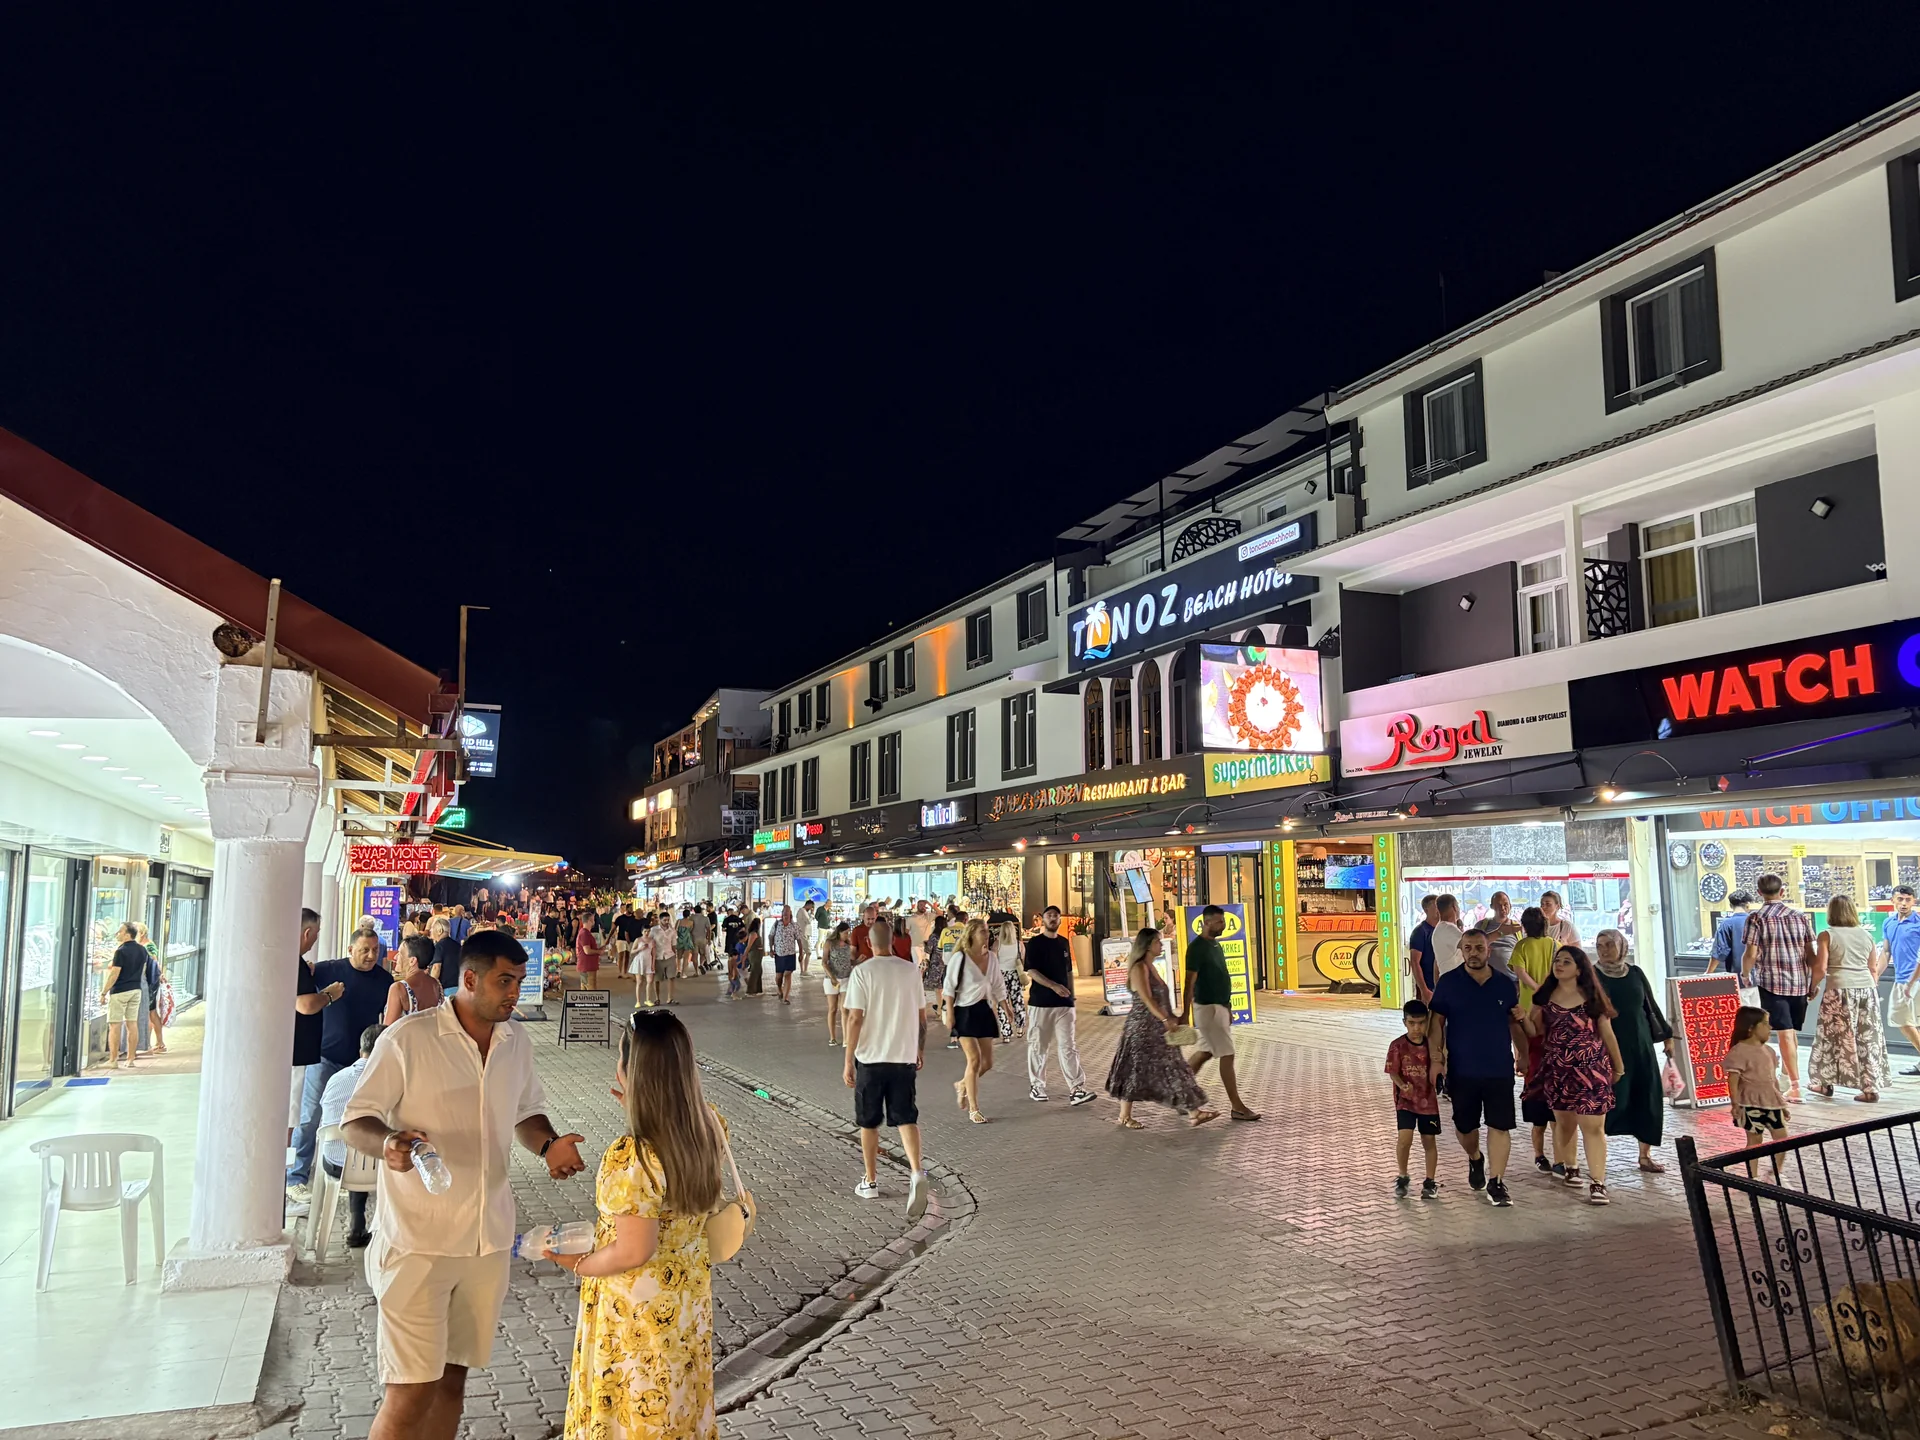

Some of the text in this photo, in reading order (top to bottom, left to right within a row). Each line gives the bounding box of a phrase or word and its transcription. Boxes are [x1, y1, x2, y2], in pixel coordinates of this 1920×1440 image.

[1184, 579, 1238, 623] BEACH
[1662, 644, 1875, 721] WATCH
[1497, 718, 1520, 727] DIAMOND
[1526, 715, 1537, 723] GEM
[1538, 711, 1568, 721] SPECIALIST
[476, 739, 495, 747] HILL
[1363, 710, 1499, 771] Royal
[1463, 745, 1503, 759] JEWELRY
[1213, 754, 1313, 788] supermarket
[1084, 778, 1149, 802] RESTAURANT
[1150, 776, 1159, 793] &
[1160, 773, 1187, 794] BAR
[350, 847, 437, 859] SWAP MONEY
[361, 860, 431, 870] CASH POINT
[370, 897, 393, 908] BUZ
[1273, 842, 1285, 982] supermarket
[1378, 836, 1391, 999] supermarket
[1333, 952, 1352, 960] AZD
[1696, 998, 1738, 1016] 63.50
